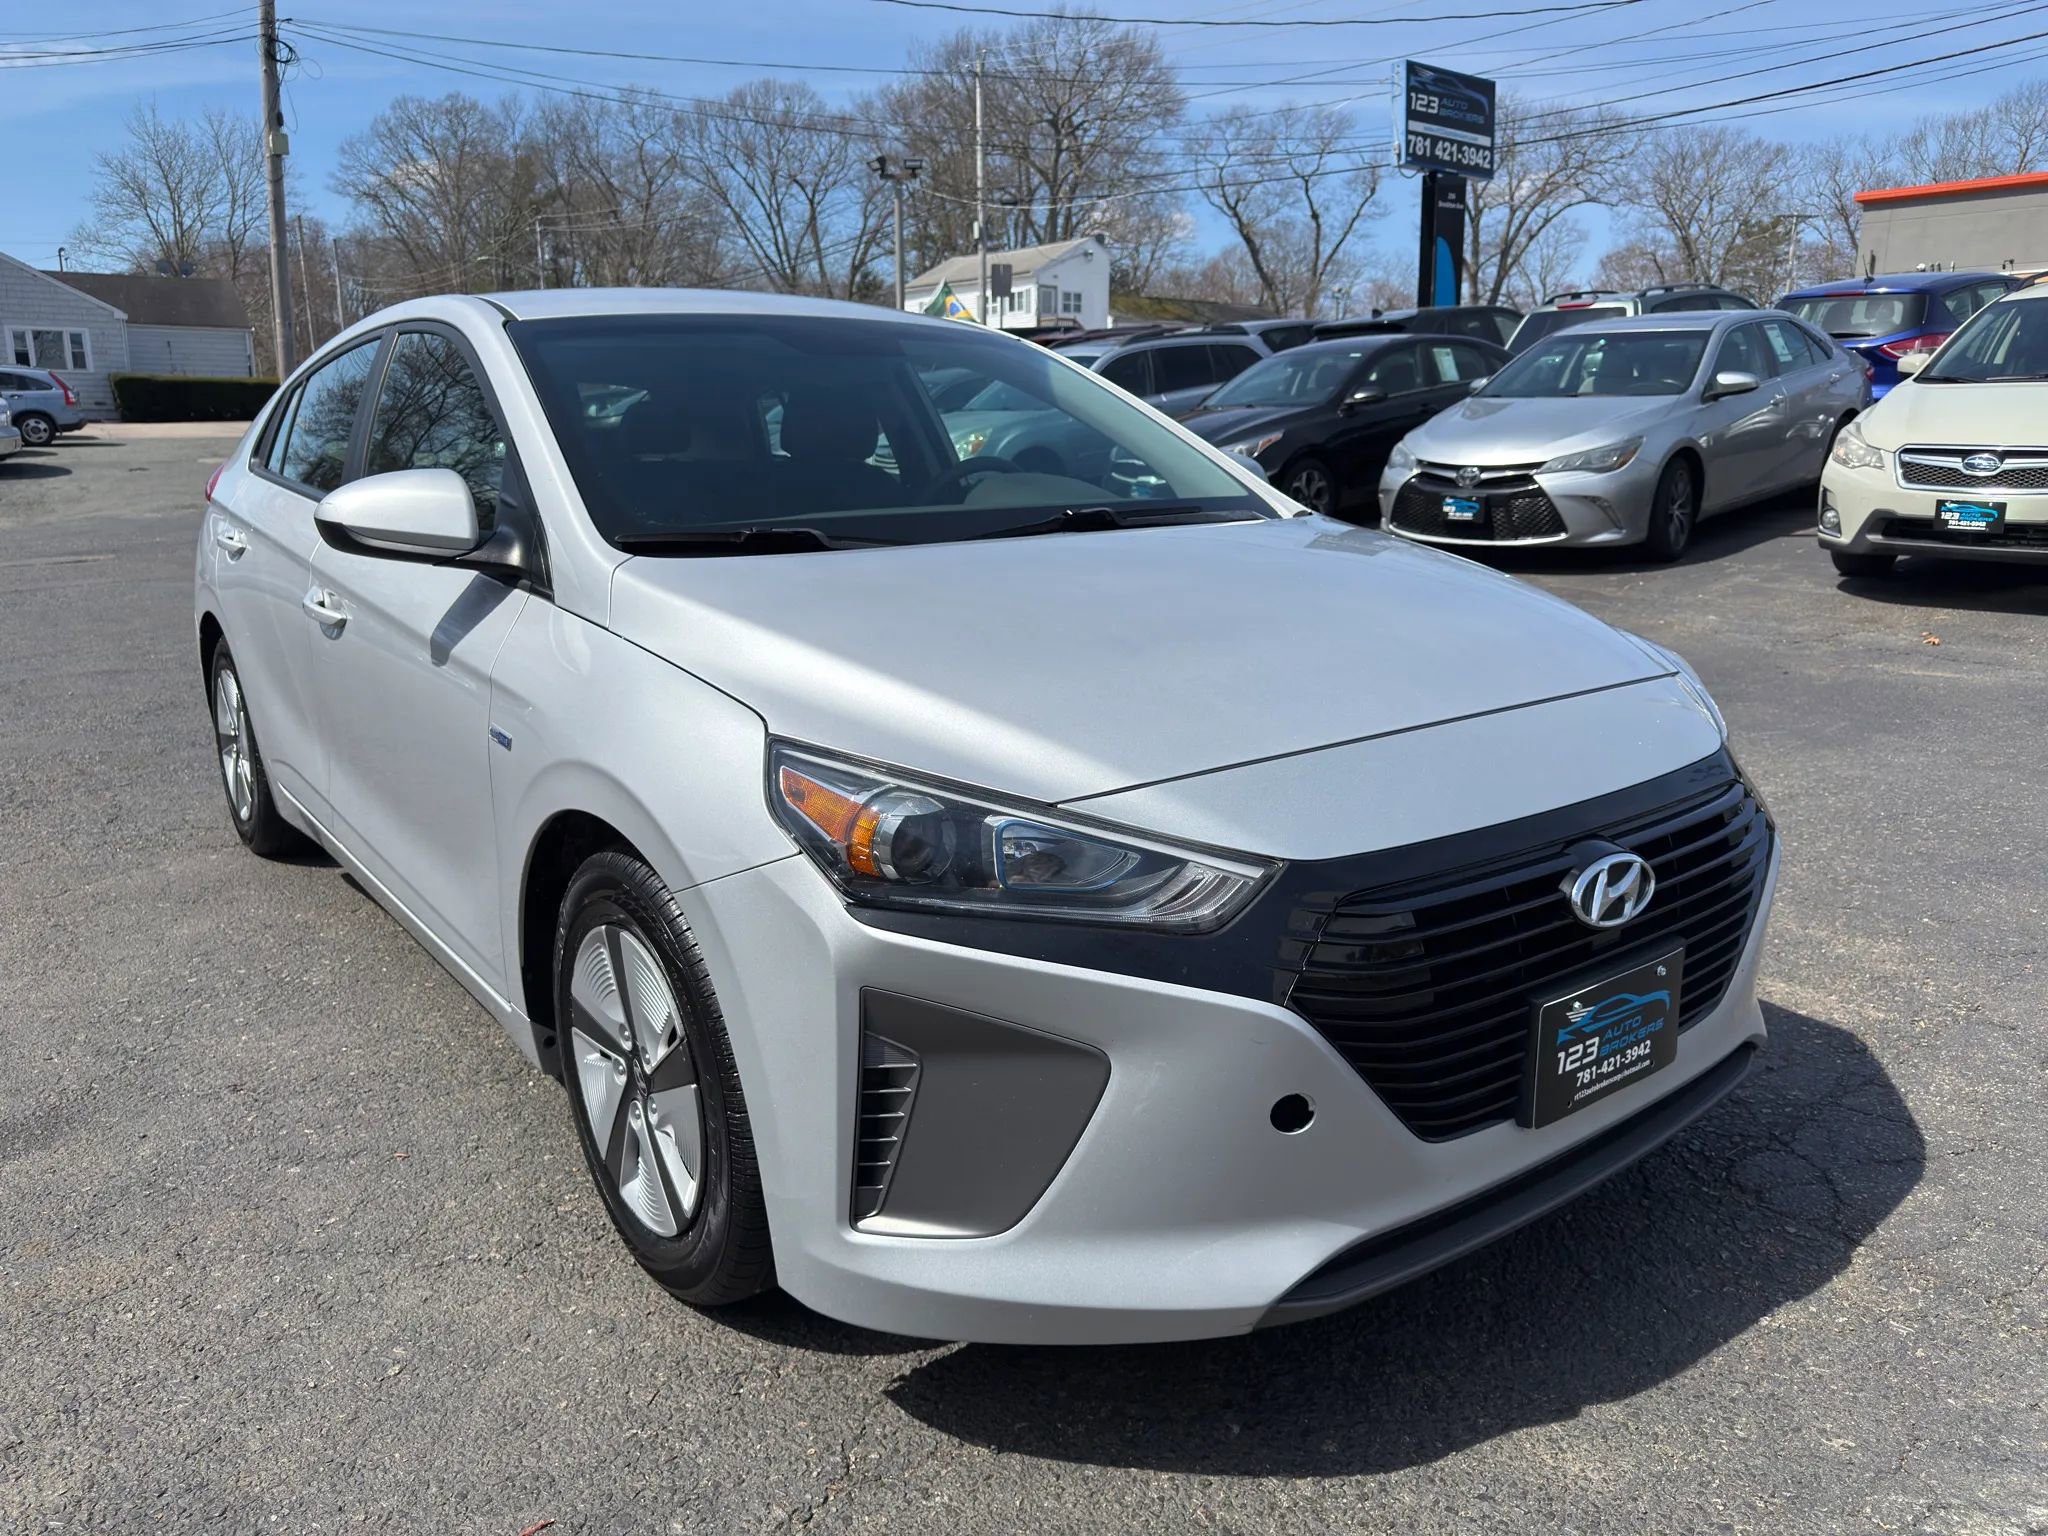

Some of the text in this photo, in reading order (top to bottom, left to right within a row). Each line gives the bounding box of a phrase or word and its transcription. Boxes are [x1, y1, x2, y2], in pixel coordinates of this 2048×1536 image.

[1410, 92, 1468, 114] 123 AUTO
[1408, 134, 1431, 157] 781
[1941, 512, 1960, 520] 123
[1603, 1016, 1642, 1040] AUTO
[1557, 1017, 1664, 1075] 123 BROKERS
[1576, 1040, 1651, 1087] 781-421-3942
